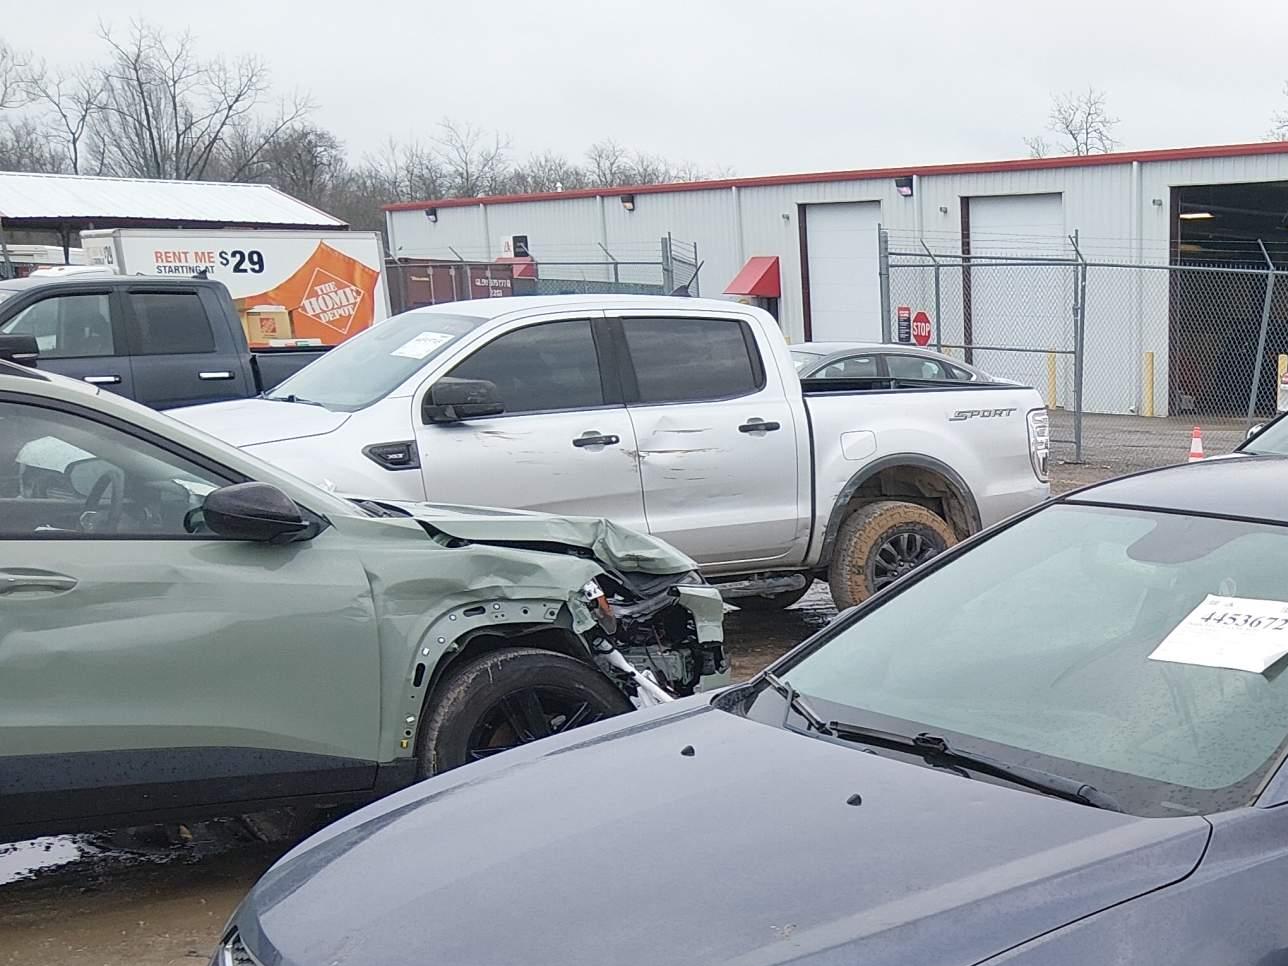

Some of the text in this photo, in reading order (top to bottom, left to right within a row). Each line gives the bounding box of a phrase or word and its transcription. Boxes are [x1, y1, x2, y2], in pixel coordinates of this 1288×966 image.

[155, 250, 265, 273] RENT ME $29
[156, 265, 200, 274] STARTING
[314, 281, 337, 295] THE
[303, 287, 361, 316] HOME
[319, 305, 355, 323] DEPOT
[913, 322, 931, 336] STOP
[948, 408, 1017, 421] SPORT
